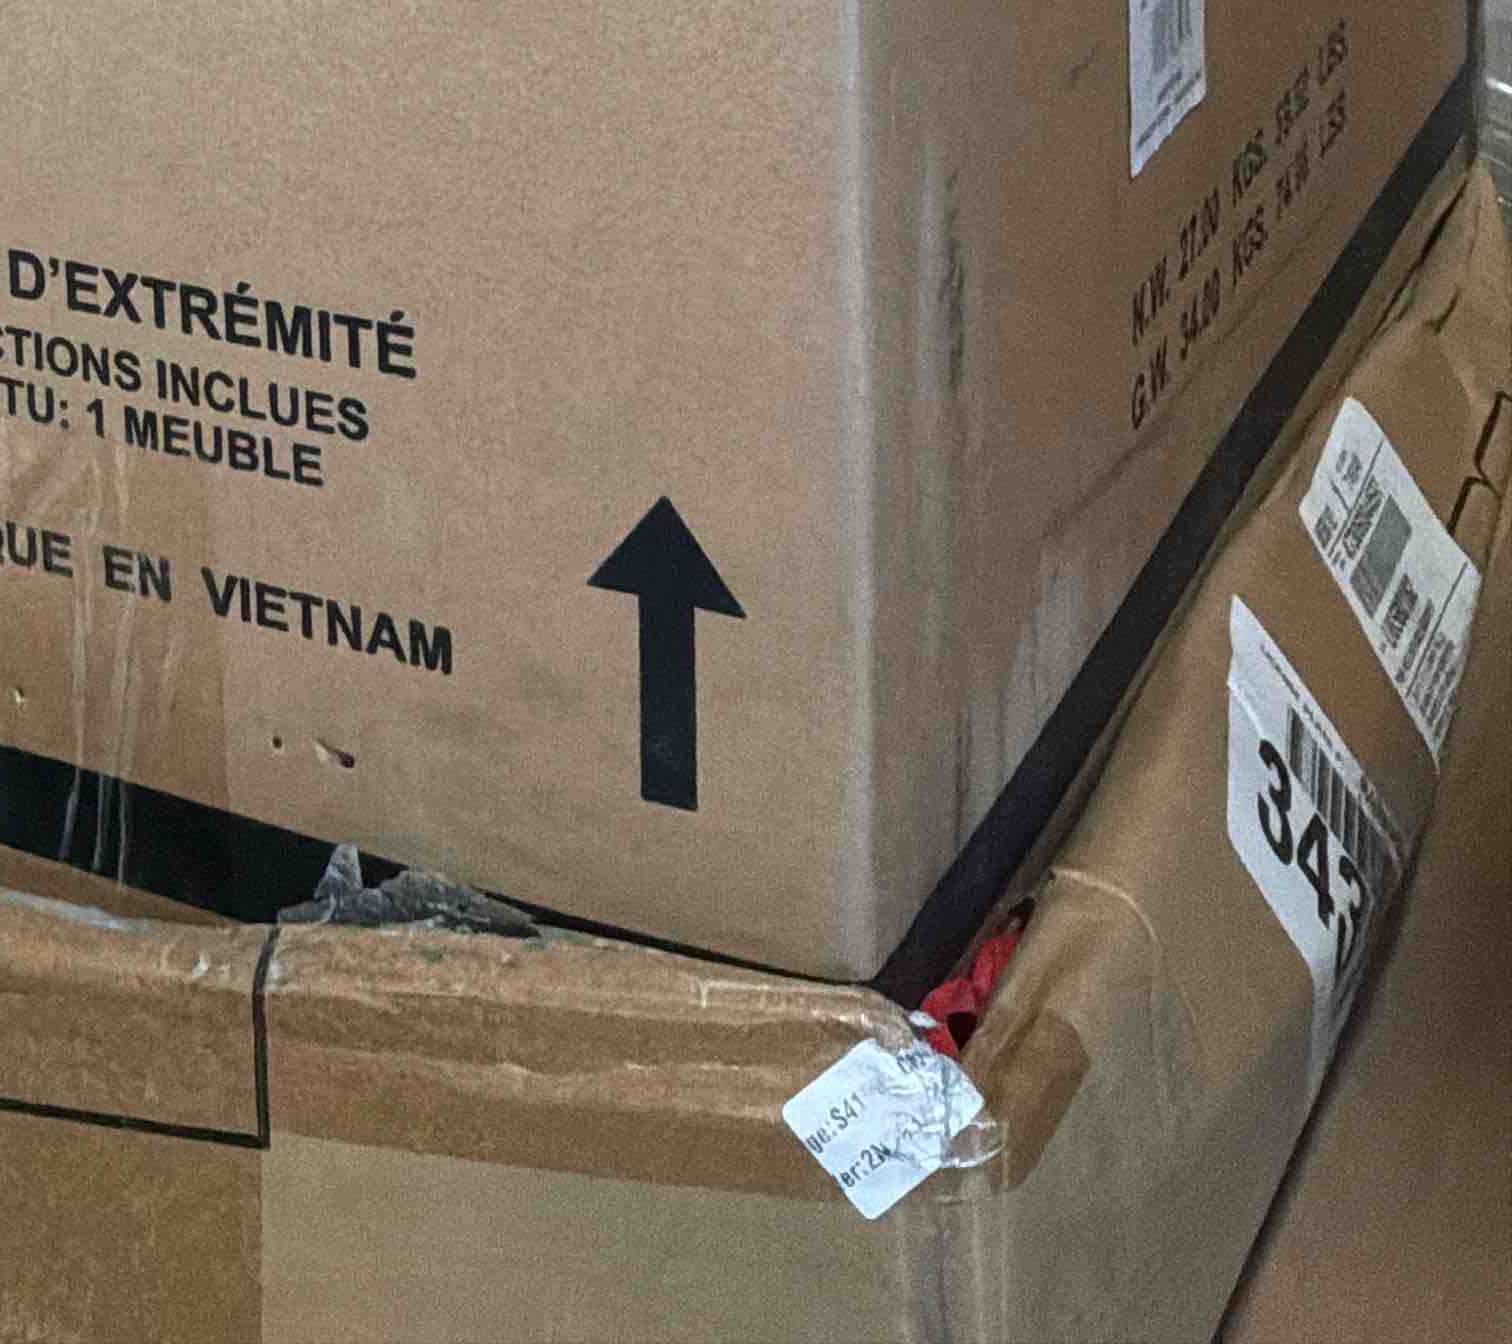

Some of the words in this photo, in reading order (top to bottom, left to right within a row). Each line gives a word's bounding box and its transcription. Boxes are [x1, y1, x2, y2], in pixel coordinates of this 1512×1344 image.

[86, 398, 107, 439] 1
[123, 405, 325, 488] MEUBLE
[156, 358, 371, 441] INCLUES
[102, 544, 174, 603] EN
[200, 566, 454, 676] VIETNAM
